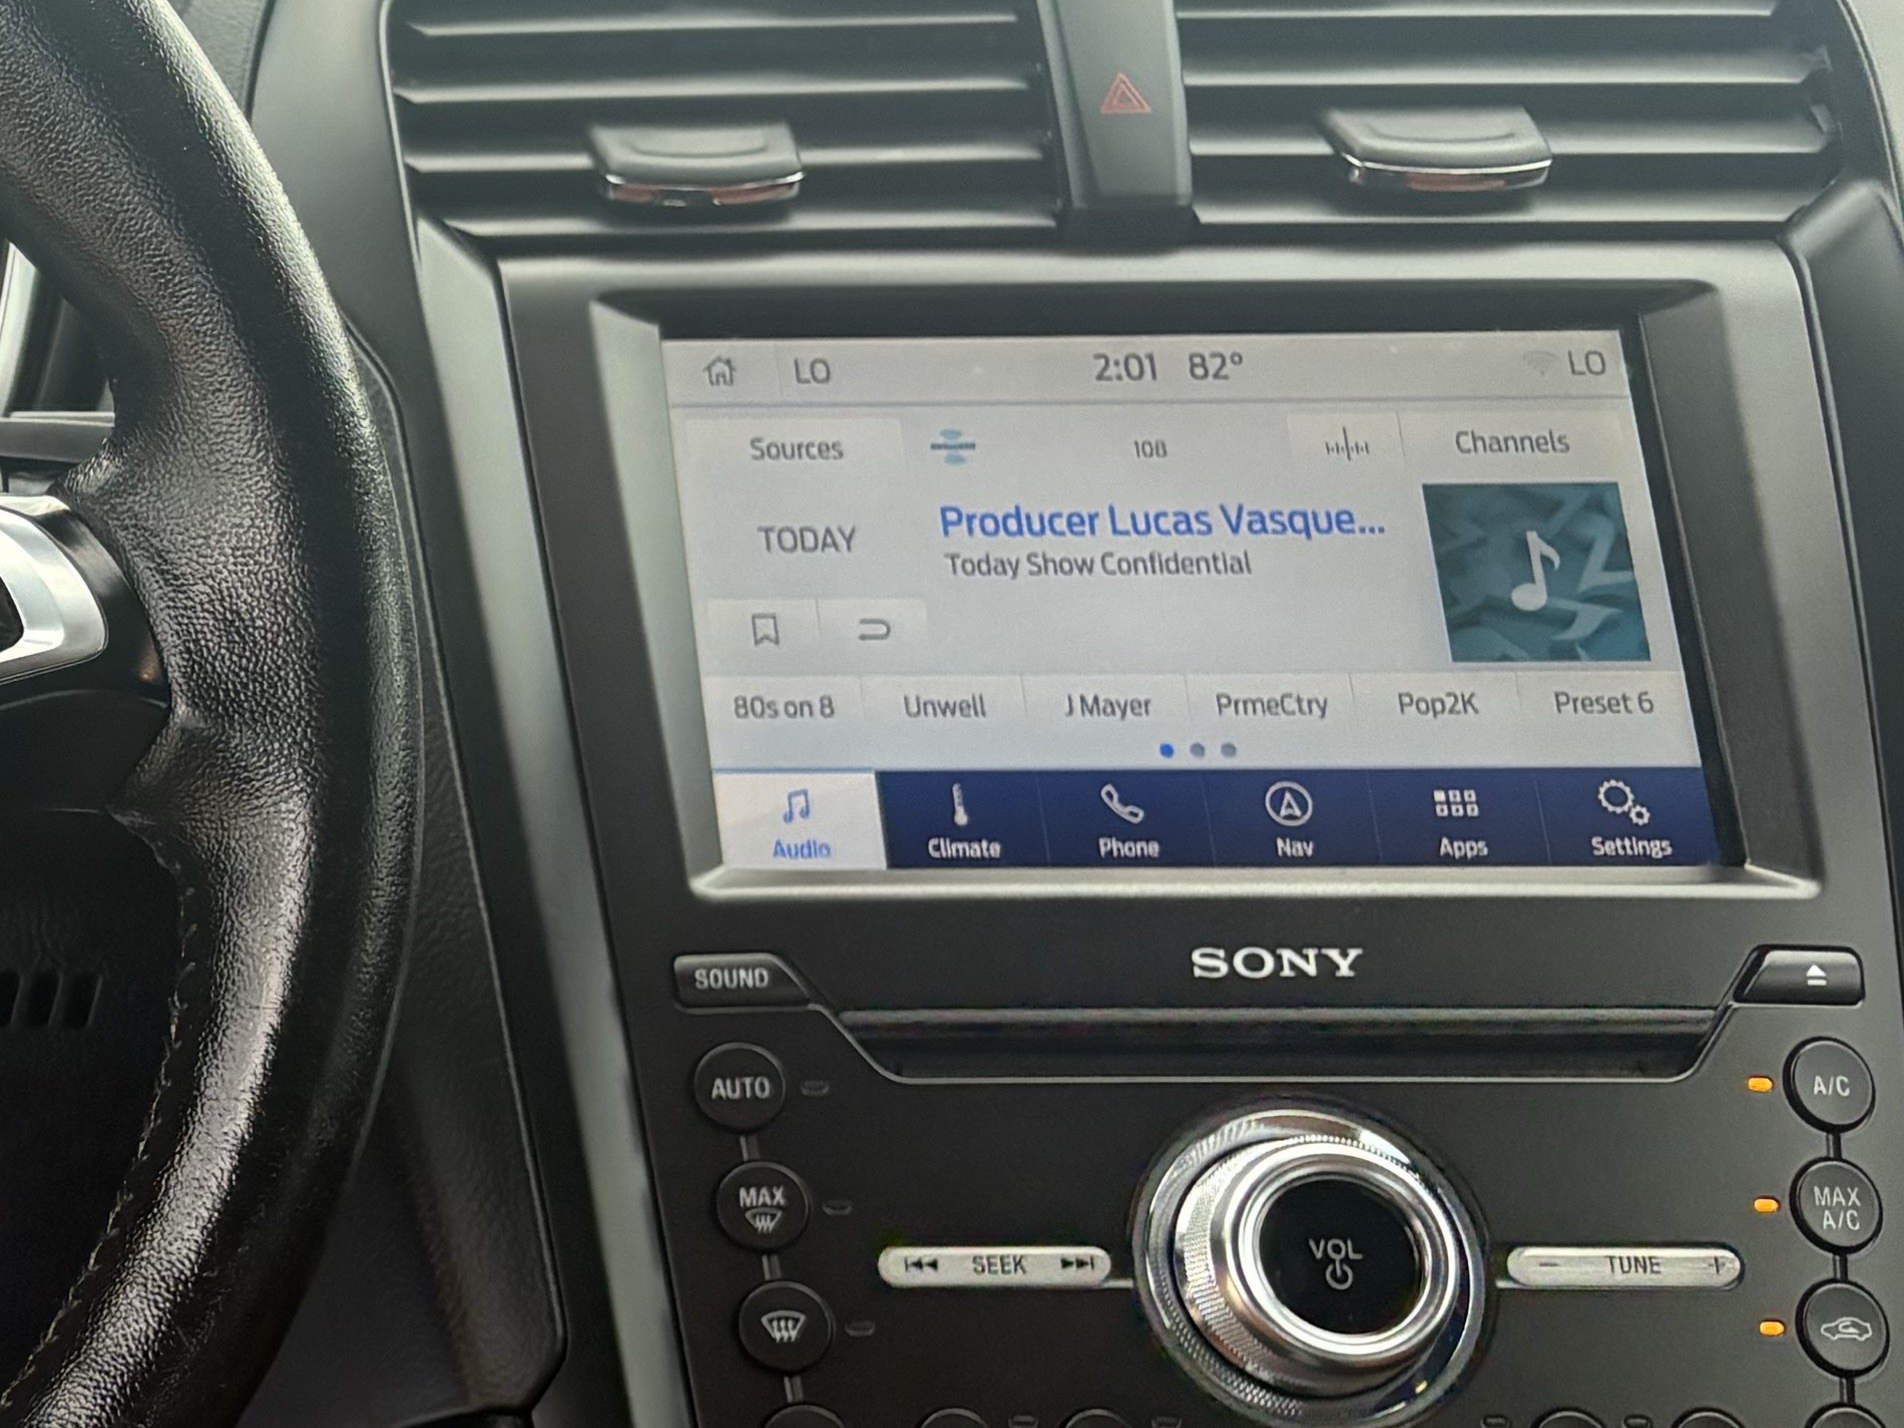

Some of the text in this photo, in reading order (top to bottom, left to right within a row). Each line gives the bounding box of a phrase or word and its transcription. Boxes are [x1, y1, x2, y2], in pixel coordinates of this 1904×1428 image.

[793, 358, 832, 385] LO
[1094, 352, 1244, 382] 2:01 82°
[1568, 350, 1607, 376] LO
[749, 437, 845, 462] Sources
[1134, 439, 1168, 460] 108
[1455, 430, 1571, 456] Channels
[939, 503, 1386, 541] Producer Lucas Vasque...
[757, 525, 856, 555] TODAY
[947, 550, 1253, 580] Today Show Confidential
[733, 694, 837, 720] 80s on 8
[903, 693, 988, 719] Unwell
[1064, 694, 1153, 721] J Mayer
[1215, 691, 1329, 720] PrmeCtry
[1397, 691, 1480, 720] Pop2K
[1554, 690, 1656, 715] Preset 6
[772, 838, 832, 860] Audio
[927, 837, 1002, 860] Climate
[1098, 837, 1161, 859] Phone
[1276, 837, 1315, 858] Nav
[1438, 836, 1489, 860] Apps
[1590, 835, 1674, 859] Settings
[1189, 946, 1365, 980] SONY
[693, 966, 771, 990] SOUND
[710, 1076, 772, 1102] AUTO
[1812, 1075, 1852, 1098] A/C
[737, 1185, 786, 1208] MAX
[1813, 1185, 1862, 1208] MAX
[1821, 1210, 1861, 1232] A/C
[1308, 1238, 1365, 1262] VOL
[970, 1254, 1028, 1276] SEEK
[1604, 1255, 1663, 1276] TUNE
